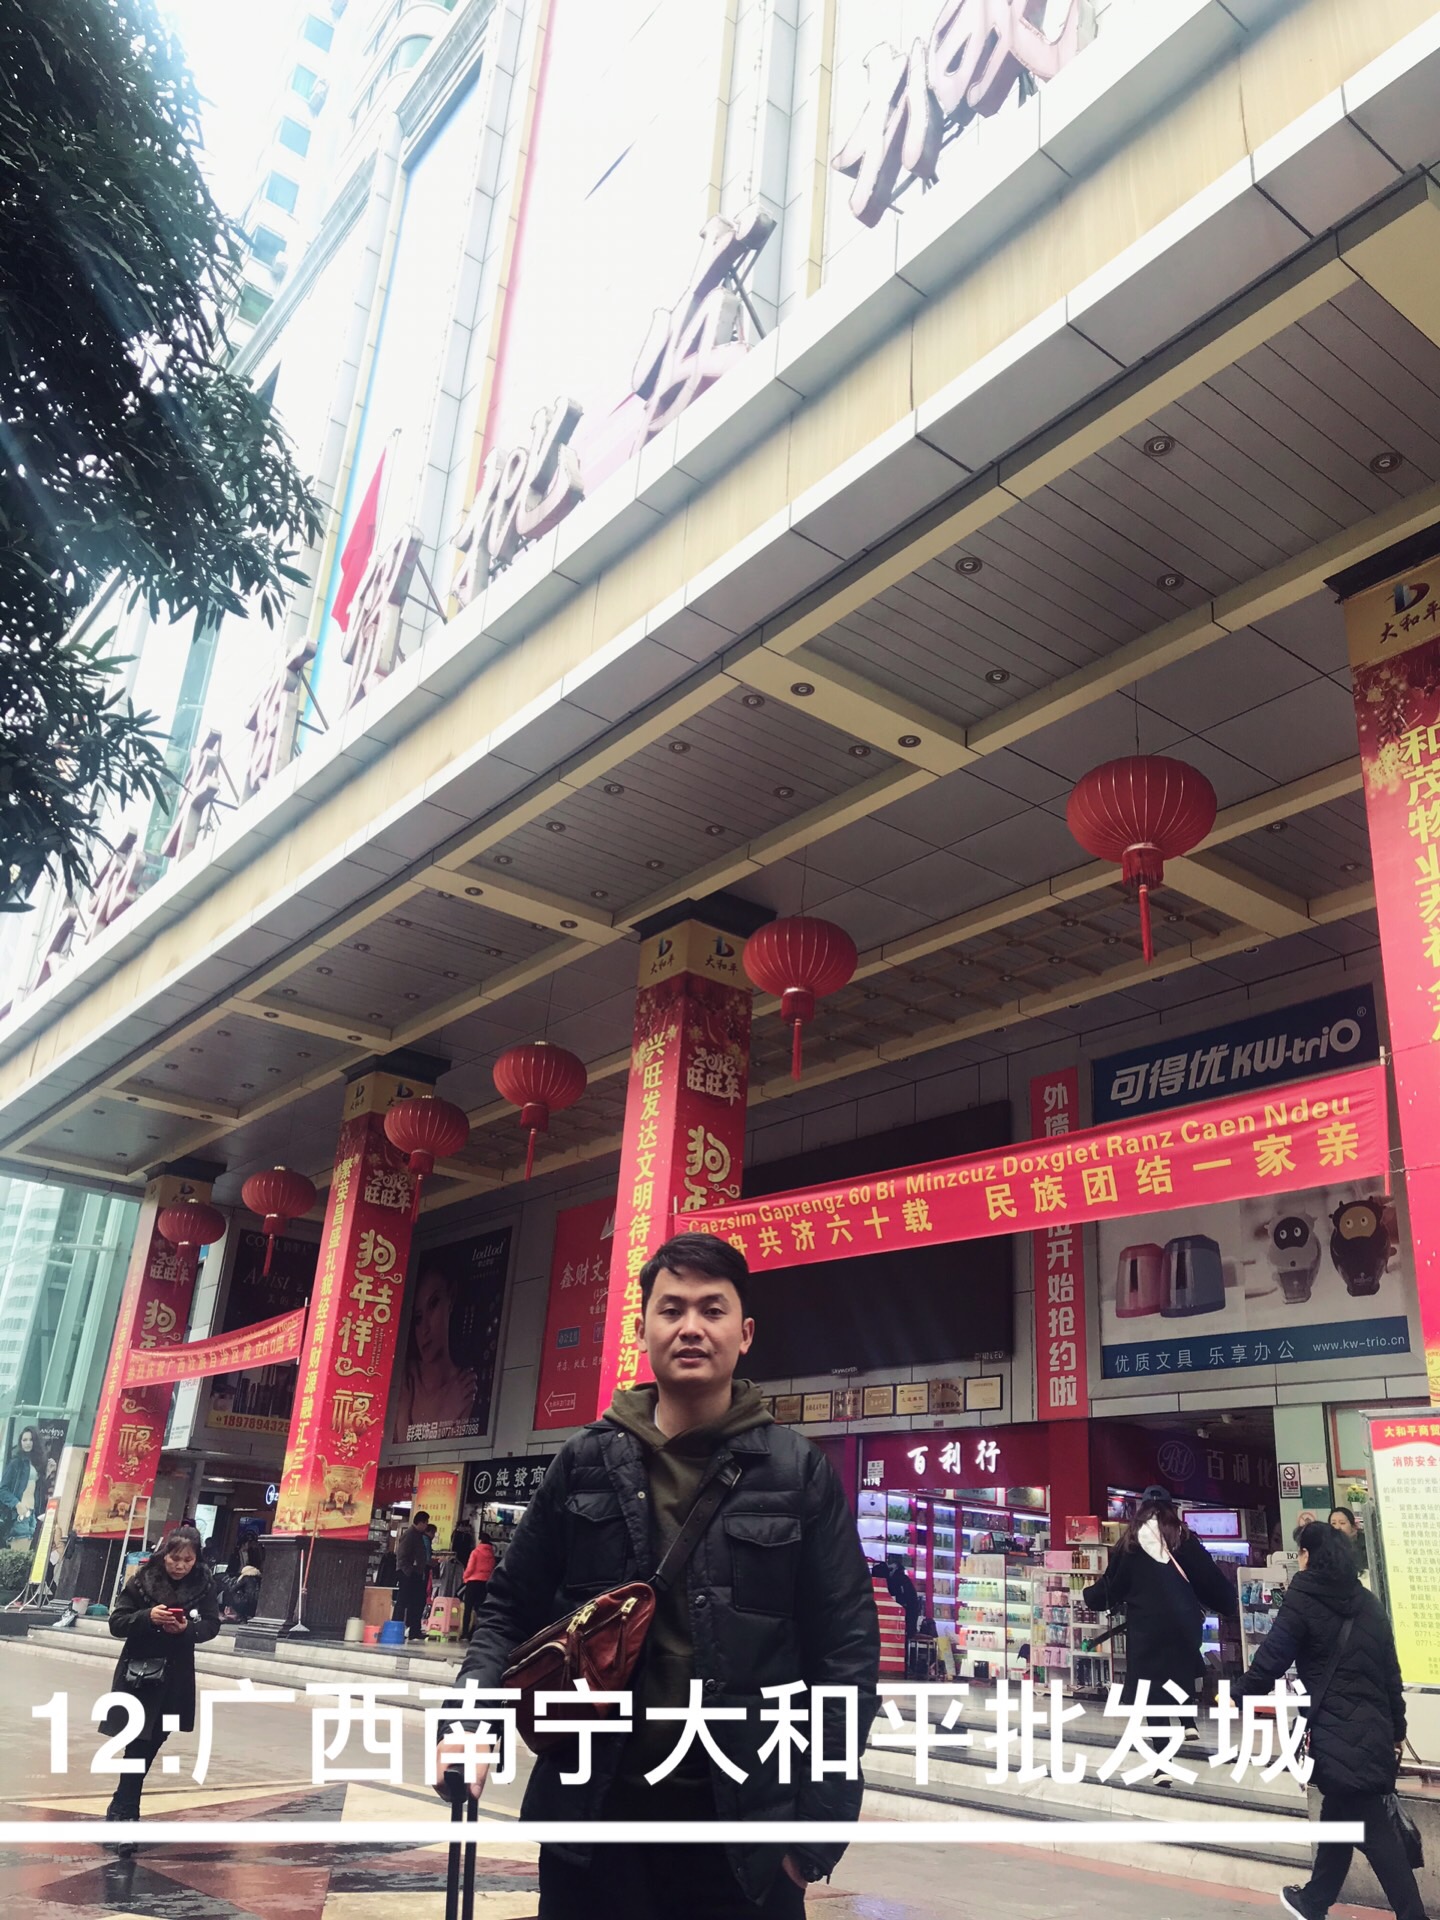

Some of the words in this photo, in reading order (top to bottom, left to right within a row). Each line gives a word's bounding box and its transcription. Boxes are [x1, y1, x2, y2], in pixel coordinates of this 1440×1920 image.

[705, 955, 739, 976] 大和平
[1110, 1043, 1230, 1106] 可得优
[1231, 1018, 1361, 1074] KW-triO
[688, 1210, 757, 1235] Caezsim
[759, 1194, 845, 1225] Gaprengz
[849, 1185, 871, 1206] 60
[876, 1180, 896, 1201] Bi
[905, 1164, 997, 1195] Minzcuz
[1002, 1140, 1100, 1178] Doxgiet
[1107, 1130, 1174, 1158] Ranz
[1180, 1113, 1256, 1146] Caen
[1264, 1095, 1351, 1129] Ndeu
[984, 1122, 1360, 1222] 民族团结一家亲
[560, 1254, 611, 1290] 鑫财文
[1114, 1346, 1193, 1374] 优质文具
[1208, 1340, 1296, 1365] 乐享办公
[1312, 1334, 1406, 1353] www.kw-trio.cn
[1384, 1424, 1440, 1438] 大和平商贸
[907, 1440, 1001, 1475] 百利行
[1392, 1455, 1440, 1467] 消防安全
